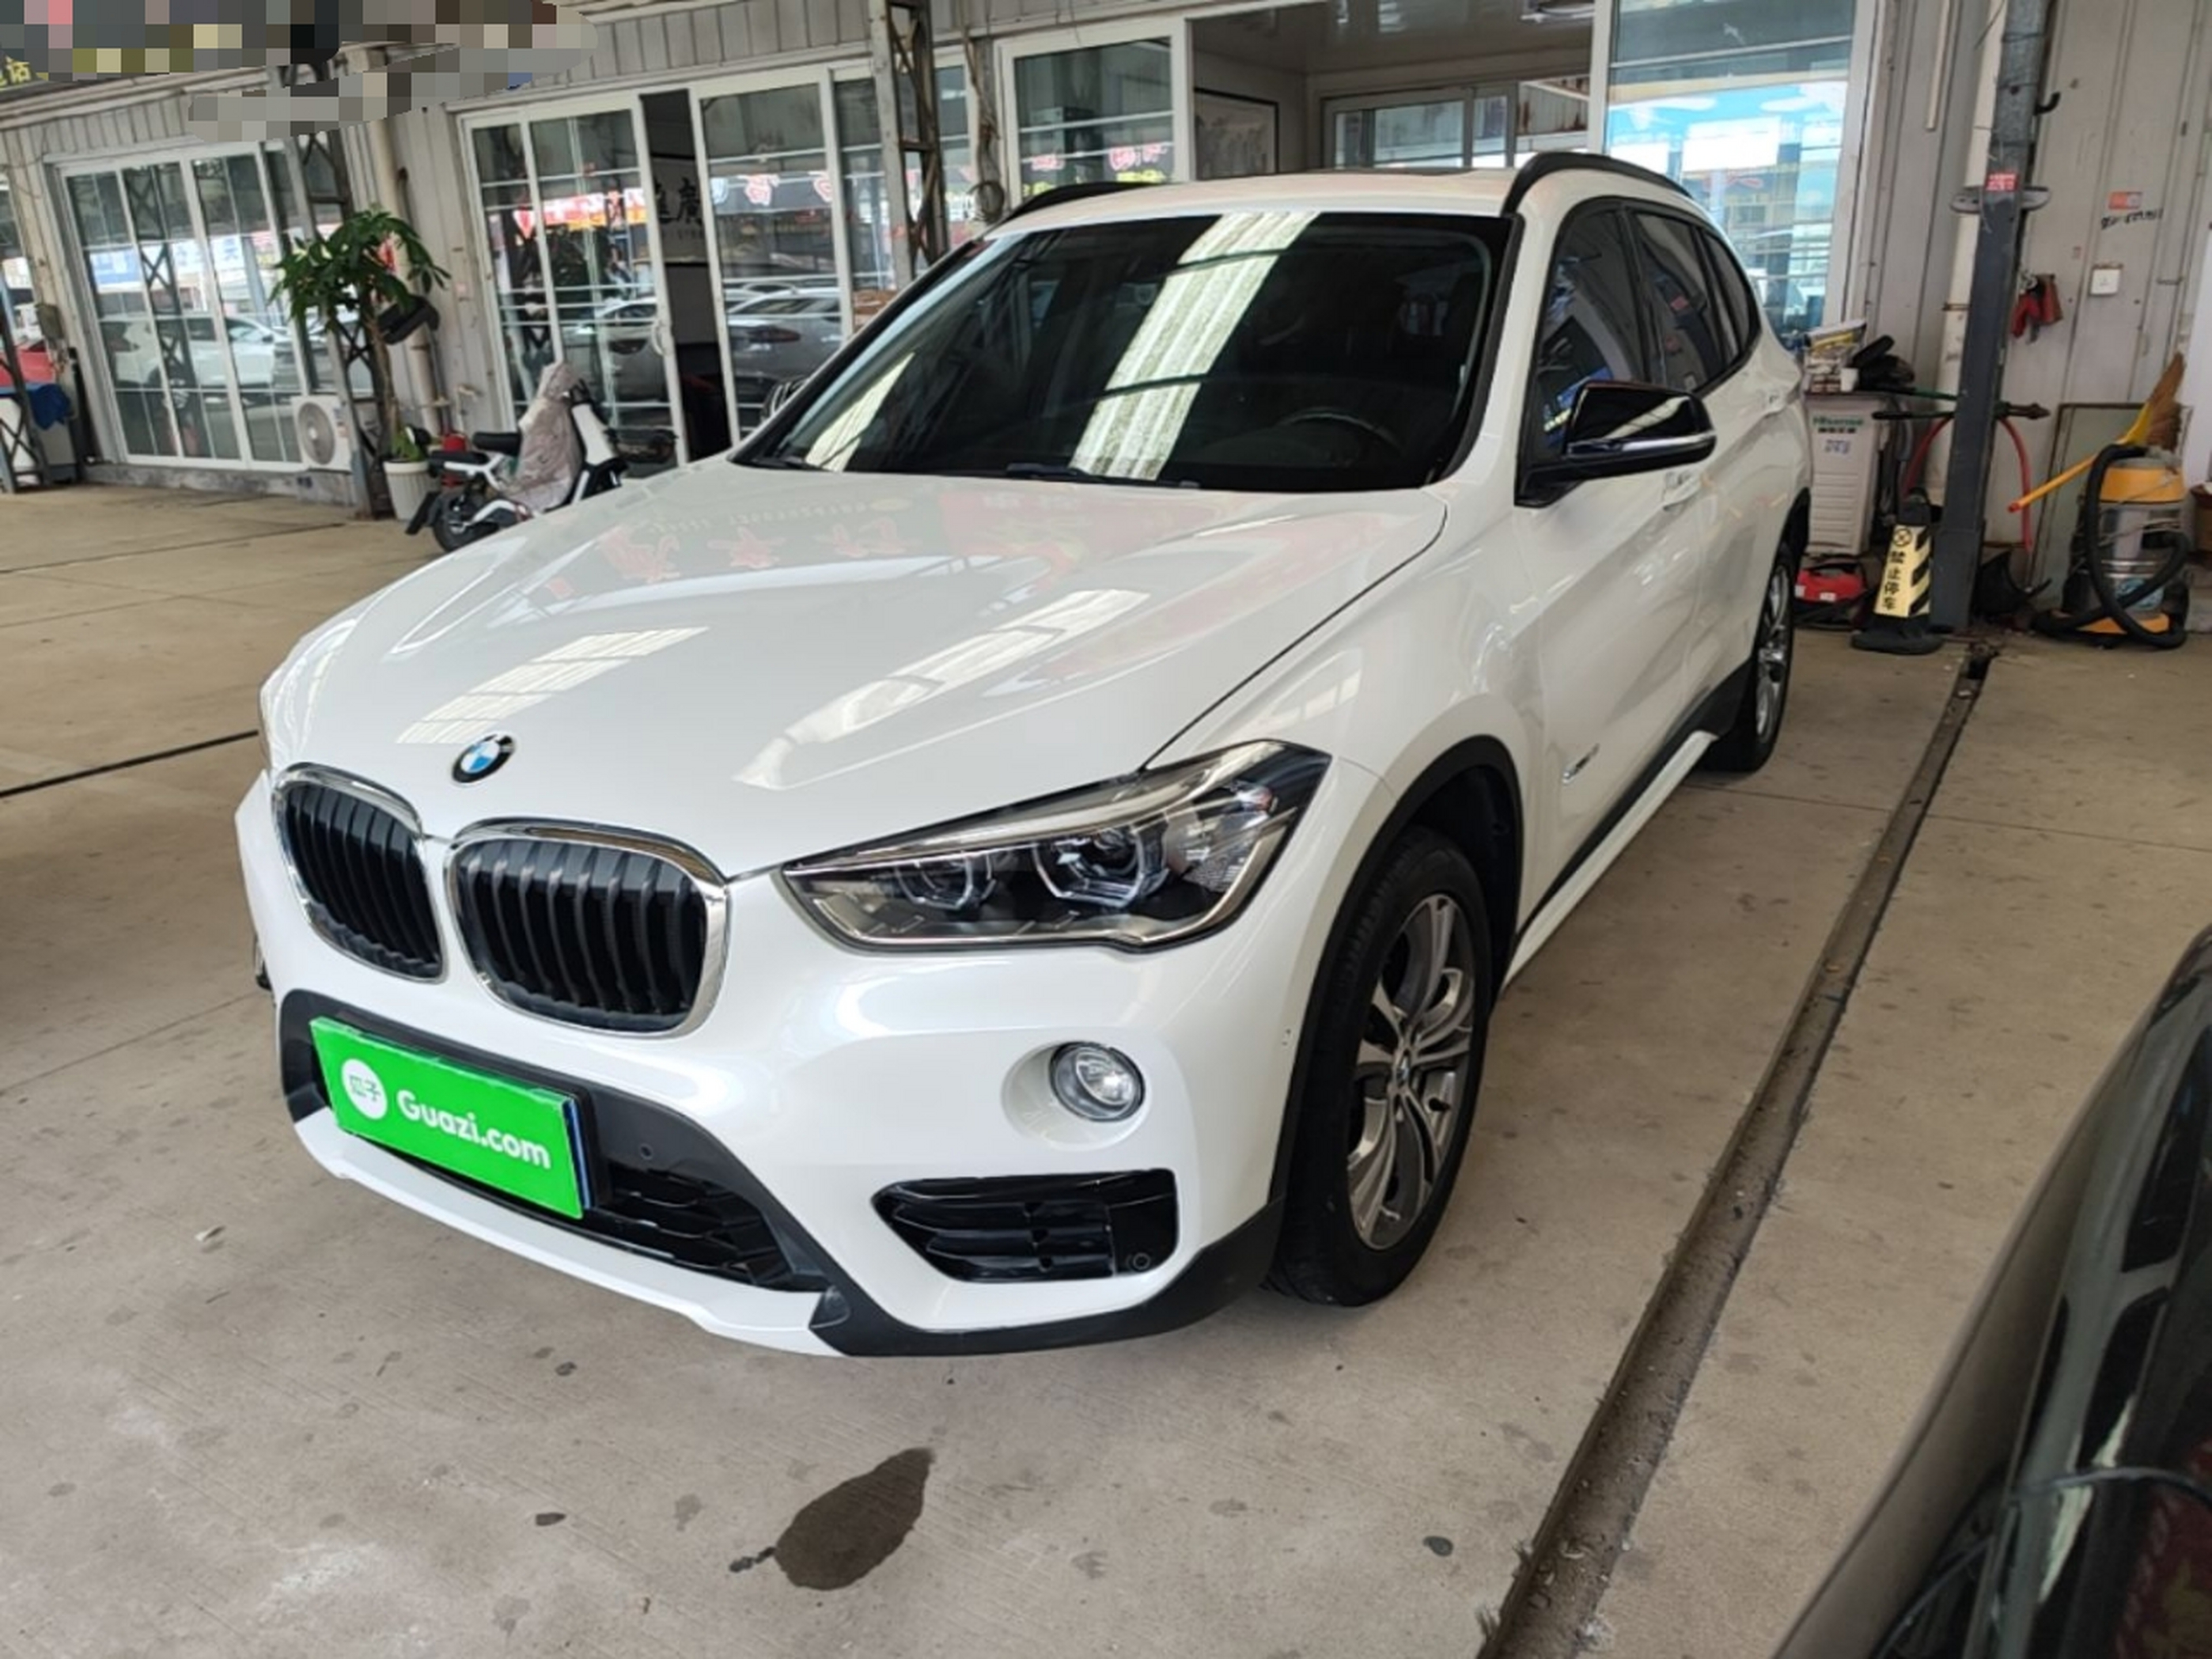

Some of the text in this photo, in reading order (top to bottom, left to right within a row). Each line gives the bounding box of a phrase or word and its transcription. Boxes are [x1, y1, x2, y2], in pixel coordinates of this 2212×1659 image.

[1883, 551, 1906, 611] 禁止停车
[397, 1089, 551, 1169] Guazi.com
